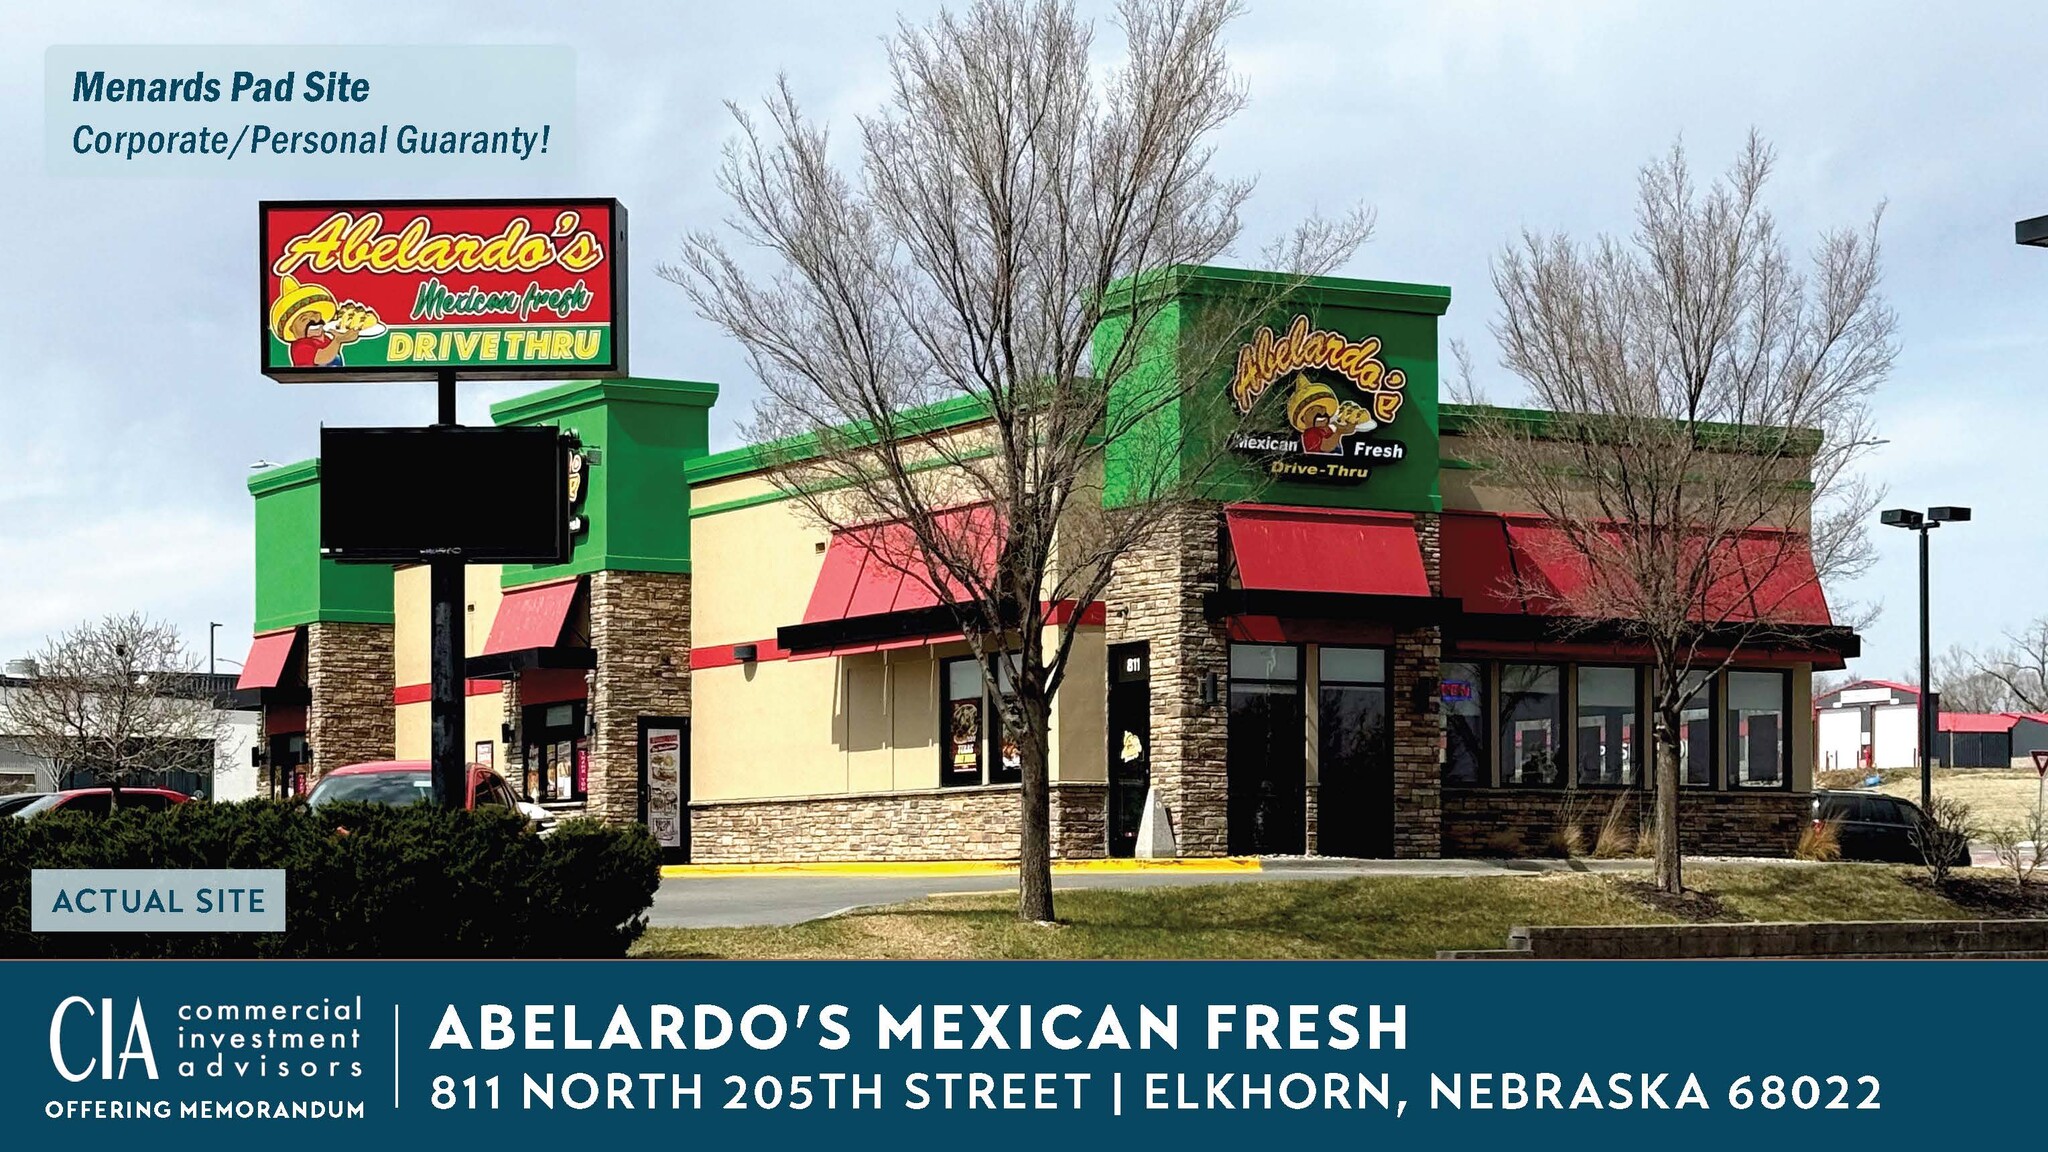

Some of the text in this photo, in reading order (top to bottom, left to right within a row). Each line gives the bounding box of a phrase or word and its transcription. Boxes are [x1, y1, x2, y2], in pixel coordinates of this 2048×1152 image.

[273, 211, 605, 275] Abelardo's
[410, 278, 594, 321] Mexican fresh
[386, 329, 602, 362] DRIVE THRU
[1233, 315, 1406, 423] Abelardo's
[1236, 436, 1403, 459] Mexican Fresh
[1271, 461, 1369, 478] Drive-Thru
[1126, 657, 1141, 672] 811
[1440, 683, 1471, 697] PEN
